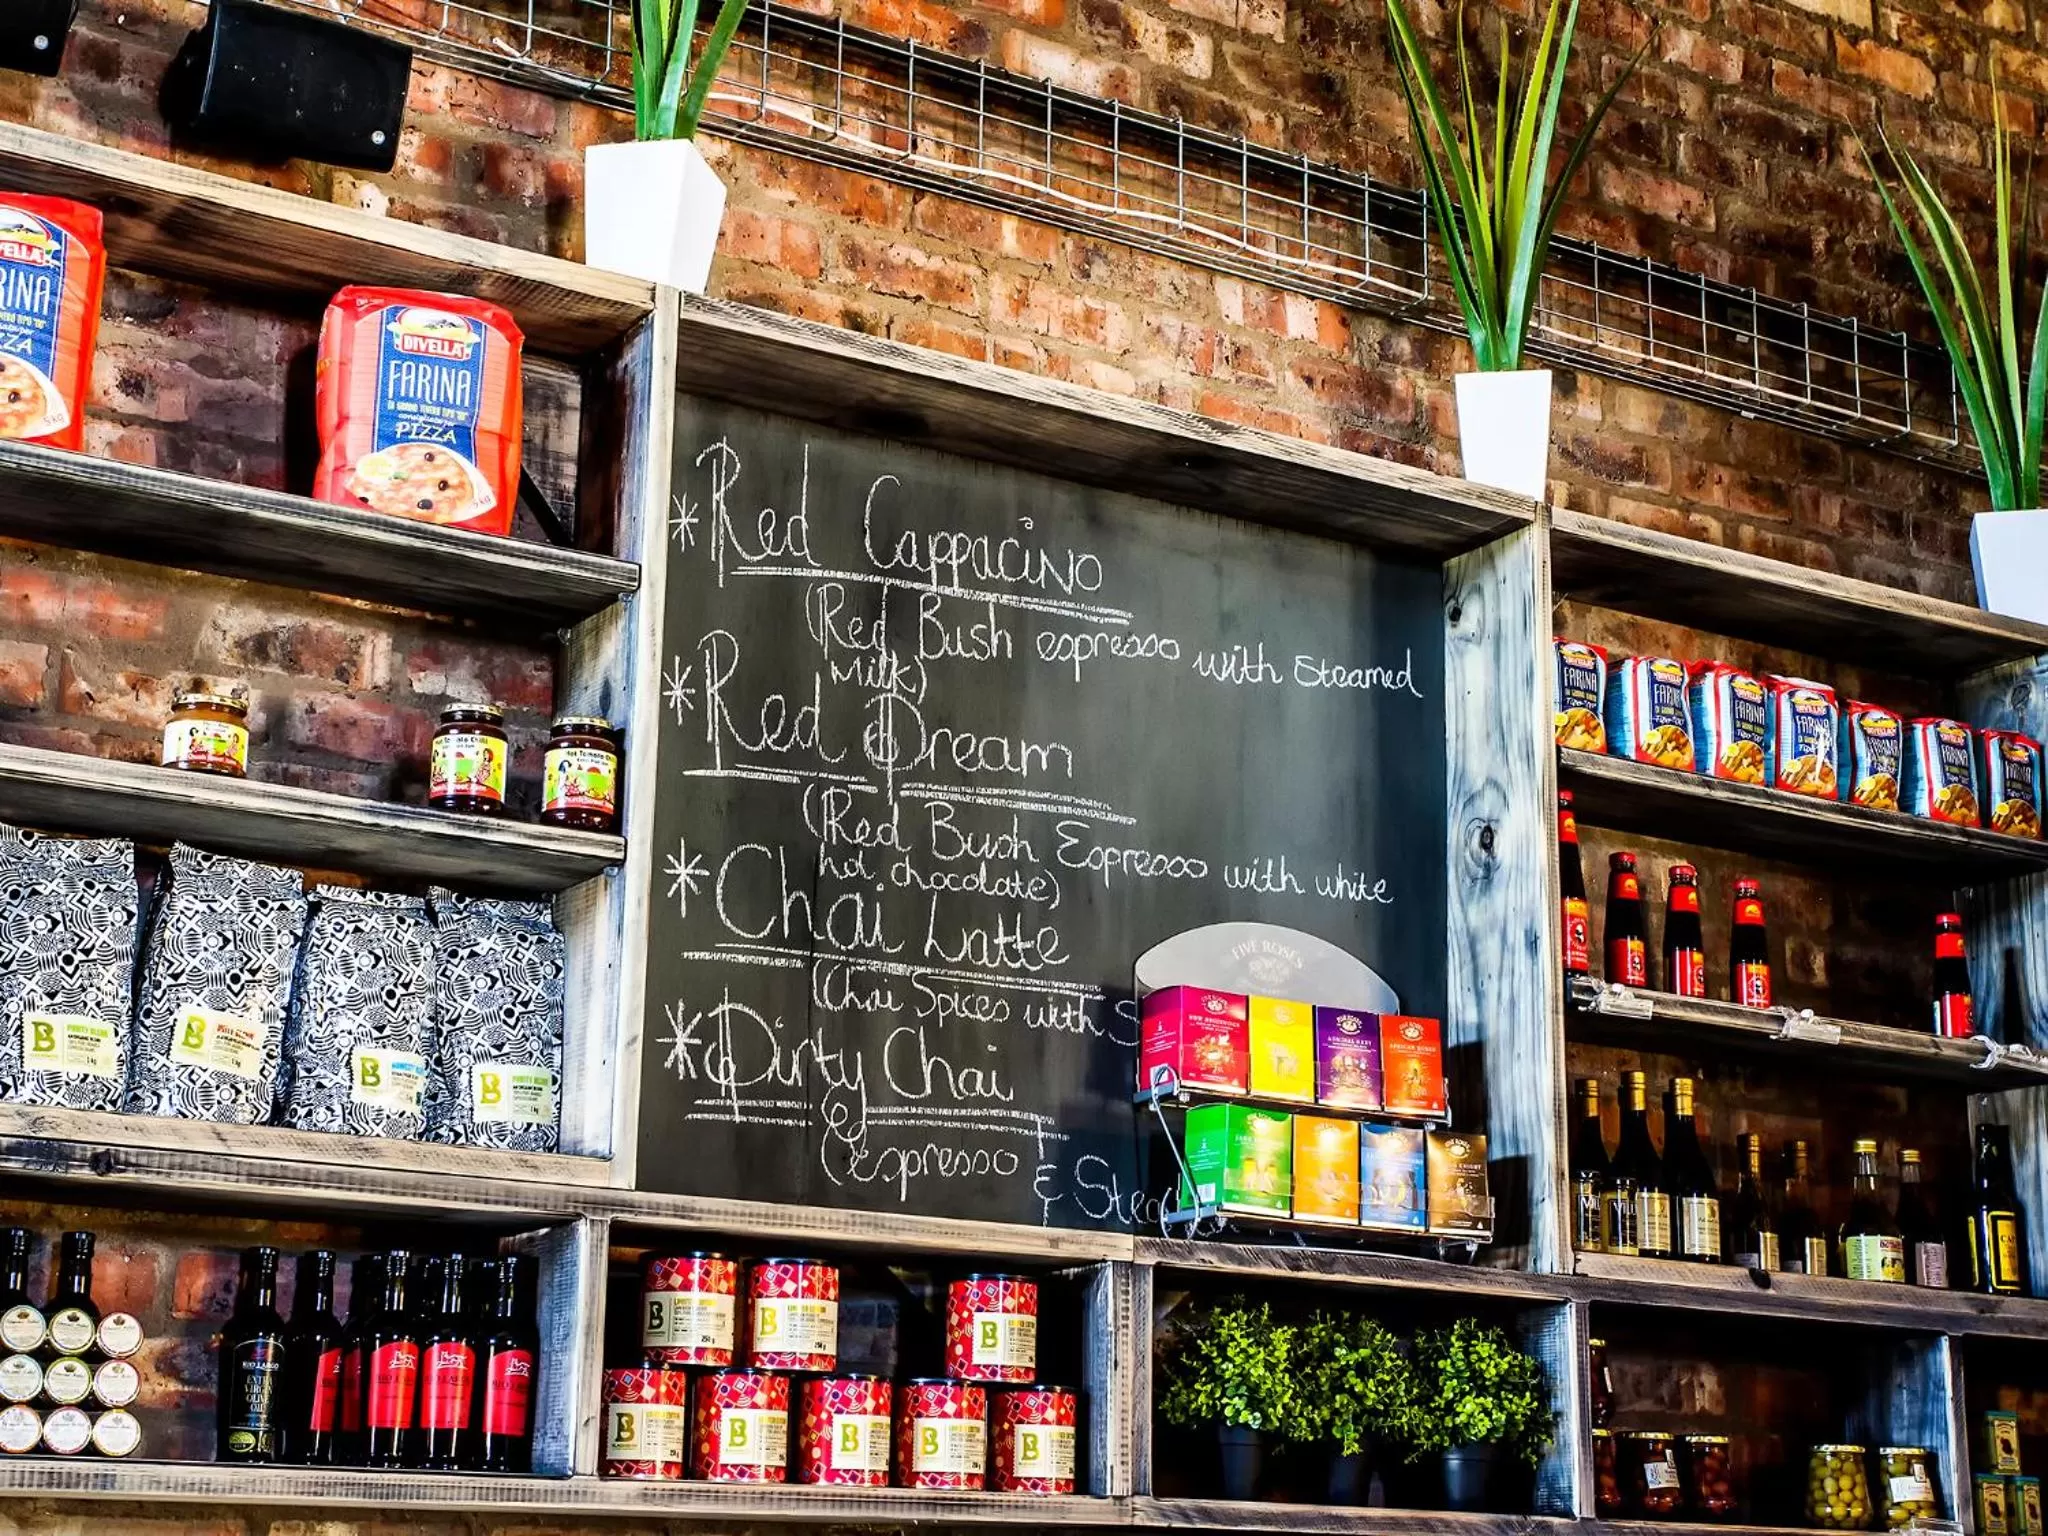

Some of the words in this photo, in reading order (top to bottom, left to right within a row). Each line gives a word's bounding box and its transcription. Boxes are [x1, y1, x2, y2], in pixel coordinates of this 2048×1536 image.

[388, 360, 472, 408] FARINA
[404, 335, 464, 359] DIVELLA
[395, 421, 457, 444] PIZZA
[697, 436, 821, 588] Red
[920, 592, 1013, 661] Bush
[1192, 642, 1283, 685] with
[697, 630, 848, 771] Red
[863, 692, 1074, 806] Dream
[924, 801, 1040, 863] Bush
[1224, 855, 1305, 896] with
[1315, 862, 1396, 904] white
[716, 843, 904, 954] Chai
[924, 891, 1070, 971] Latte
[911, 971, 1010, 1028] Spices
[1024, 996, 1106, 1037] with
[703, 984, 868, 1141] Dirty
[884, 1026, 1014, 1101] Chai
